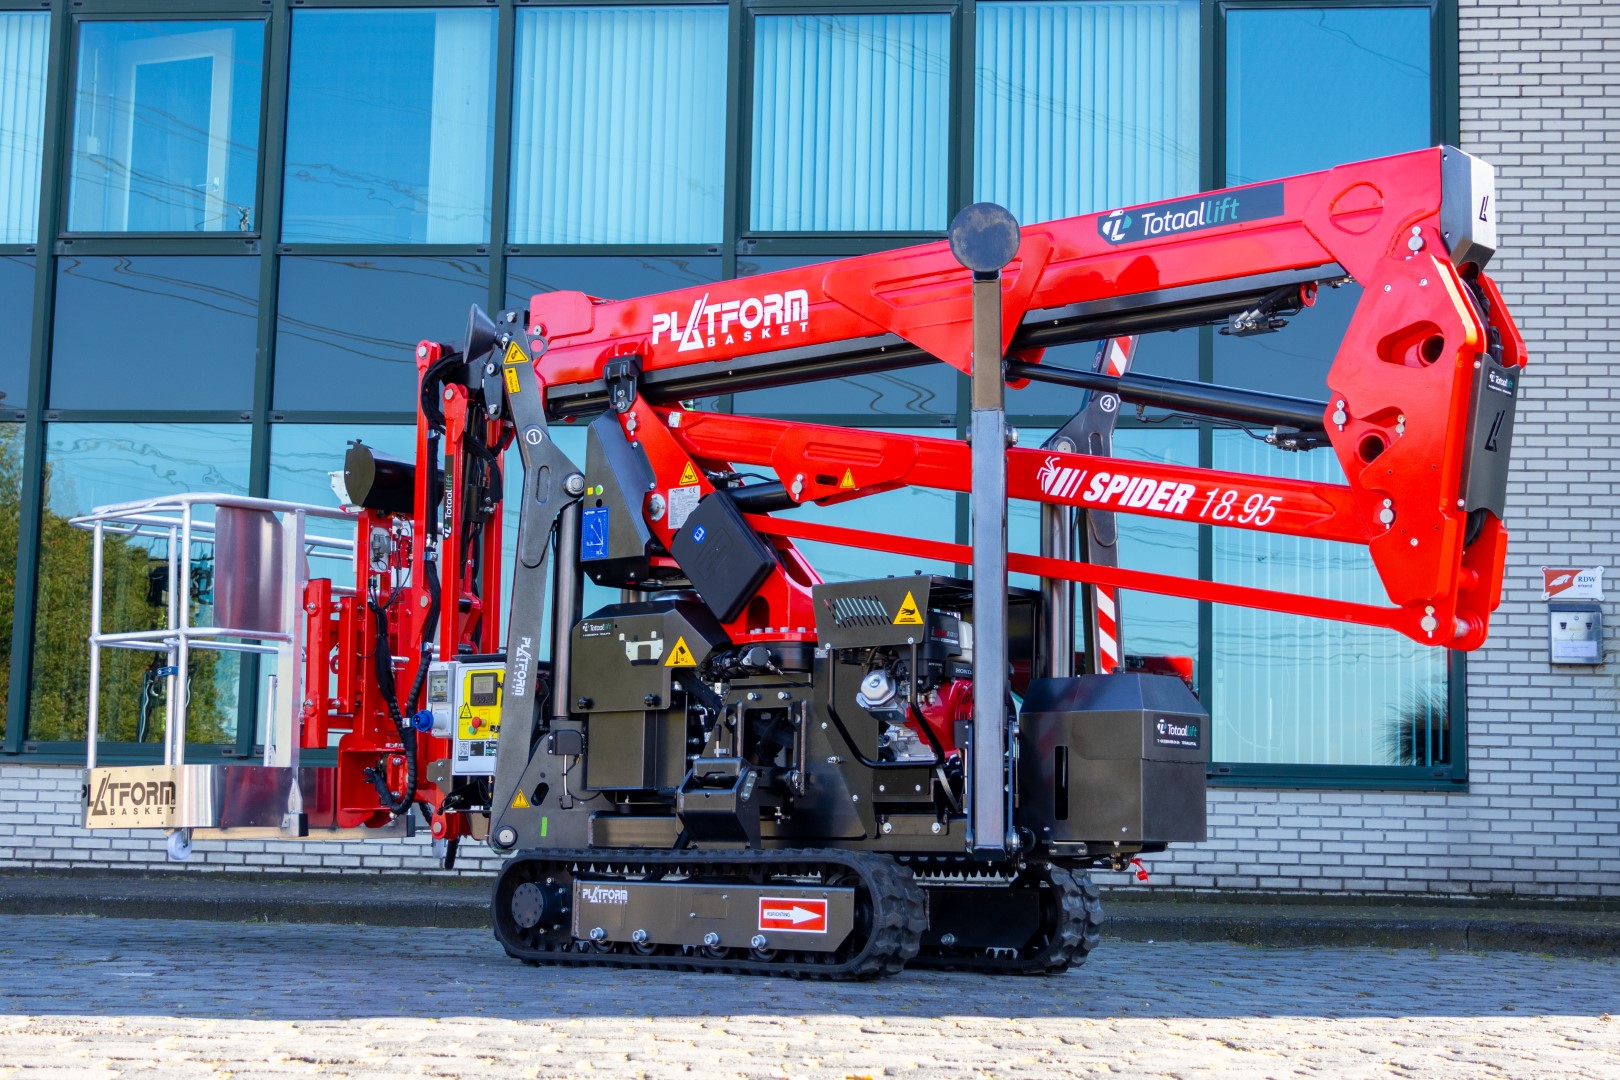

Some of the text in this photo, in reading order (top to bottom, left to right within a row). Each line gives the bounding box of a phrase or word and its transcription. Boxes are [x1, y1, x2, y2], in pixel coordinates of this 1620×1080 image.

[1142, 197, 1240, 236] Totaallift
[652, 289, 808, 352] PLATFORM
[707, 322, 808, 347] BASKET
[445, 473, 453, 520] Totaallift
[1083, 472, 1283, 527] SPIDER 18.95
[515, 637, 533, 696] PLATFORM
[1167, 723, 1198, 737] Totaallift
[109, 806, 176, 815] BASKET
[582, 885, 628, 903] PLATFORM
